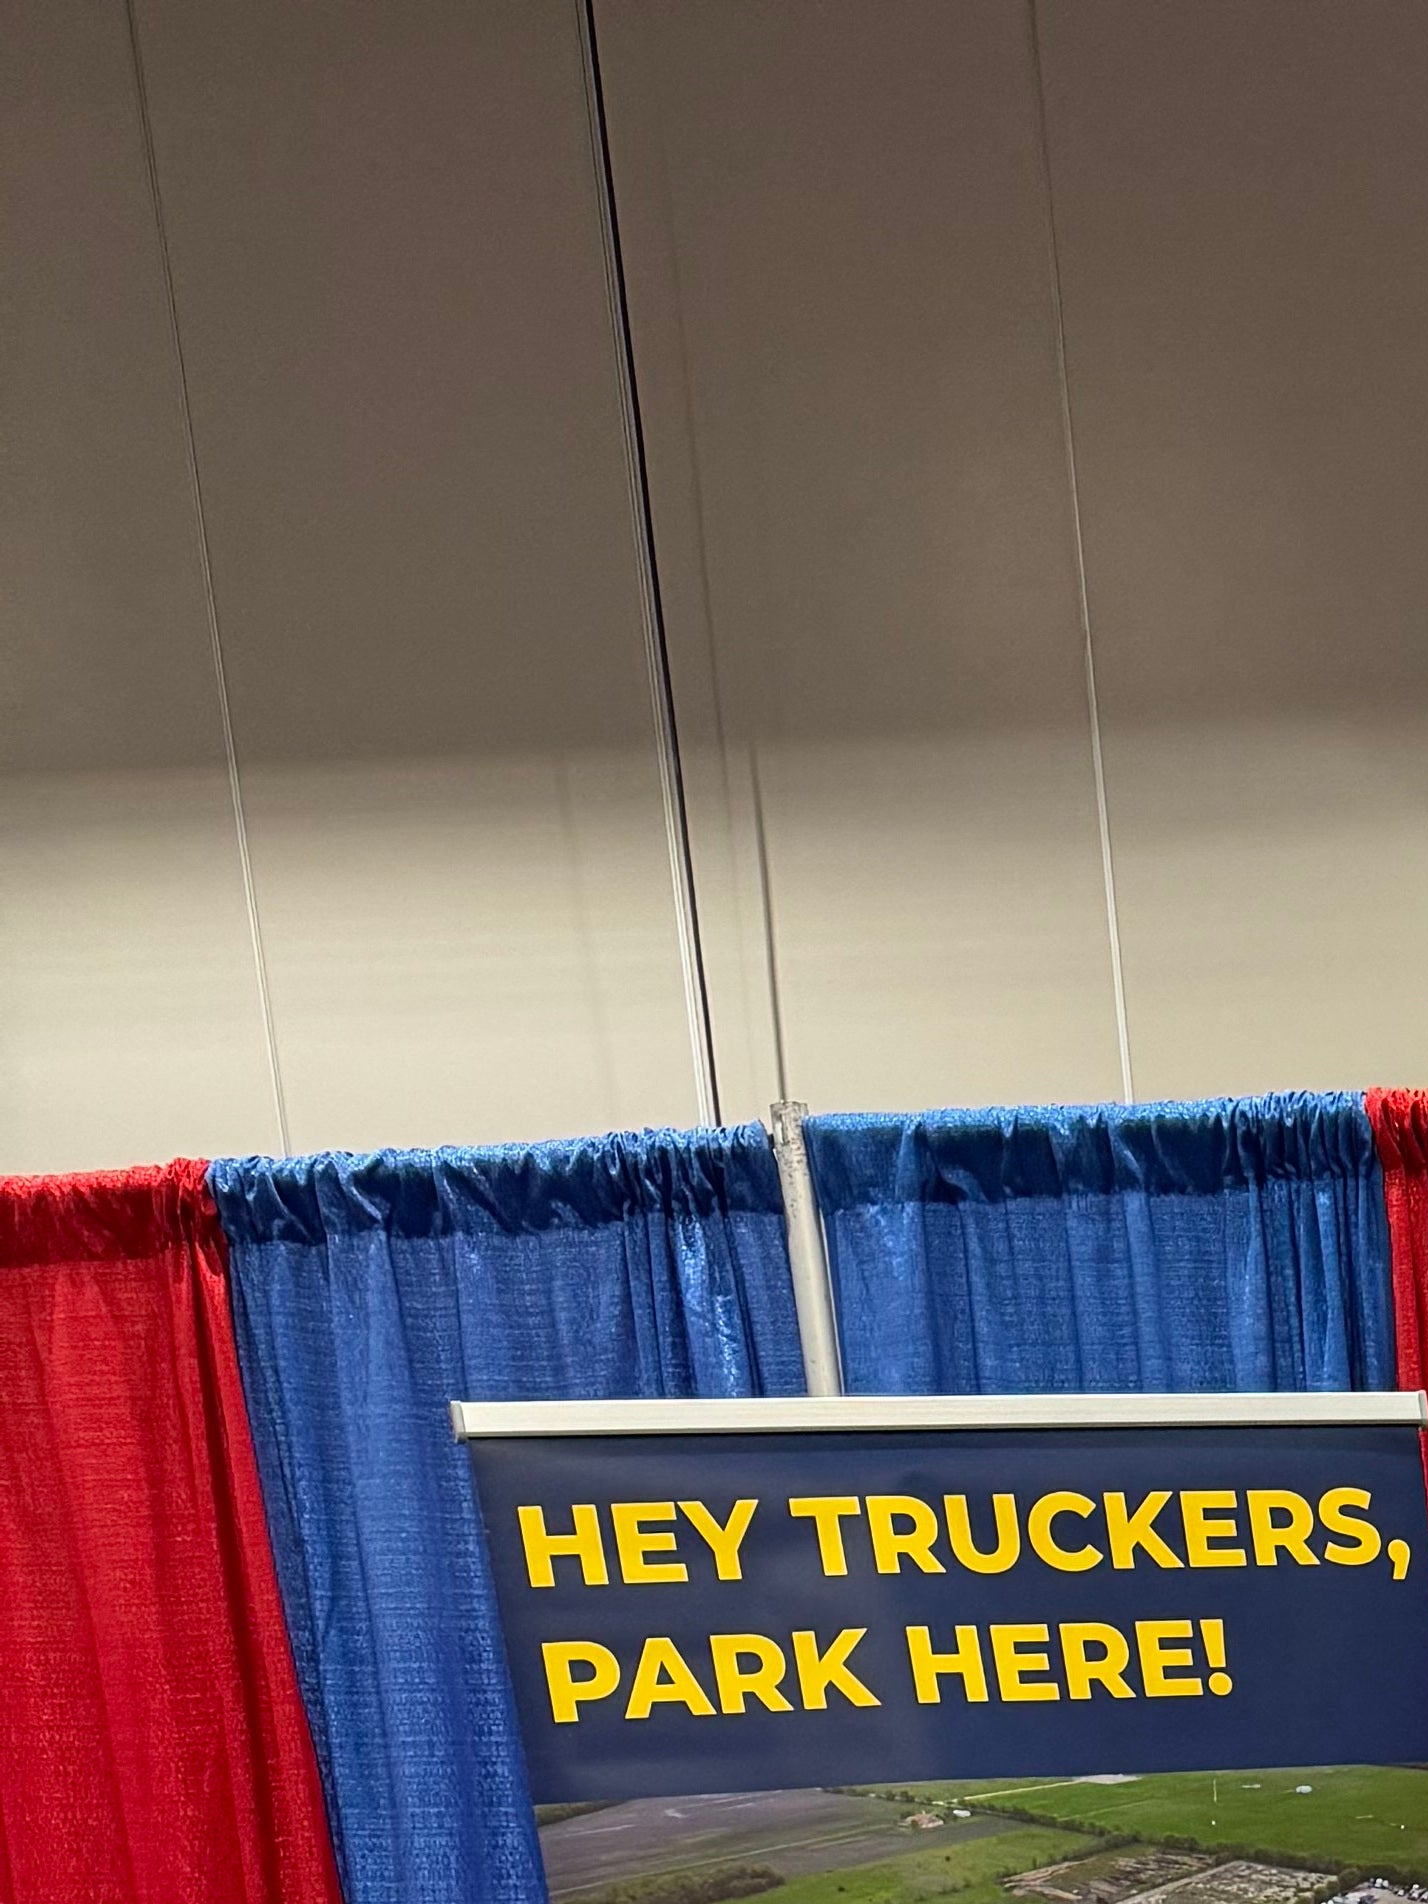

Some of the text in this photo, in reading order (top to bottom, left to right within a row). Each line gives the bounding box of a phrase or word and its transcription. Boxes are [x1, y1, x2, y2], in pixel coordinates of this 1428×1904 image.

[519, 1490, 1408, 1587] HEY TRUCKERS,
[542, 1621, 1230, 1722] PARK HERE!
